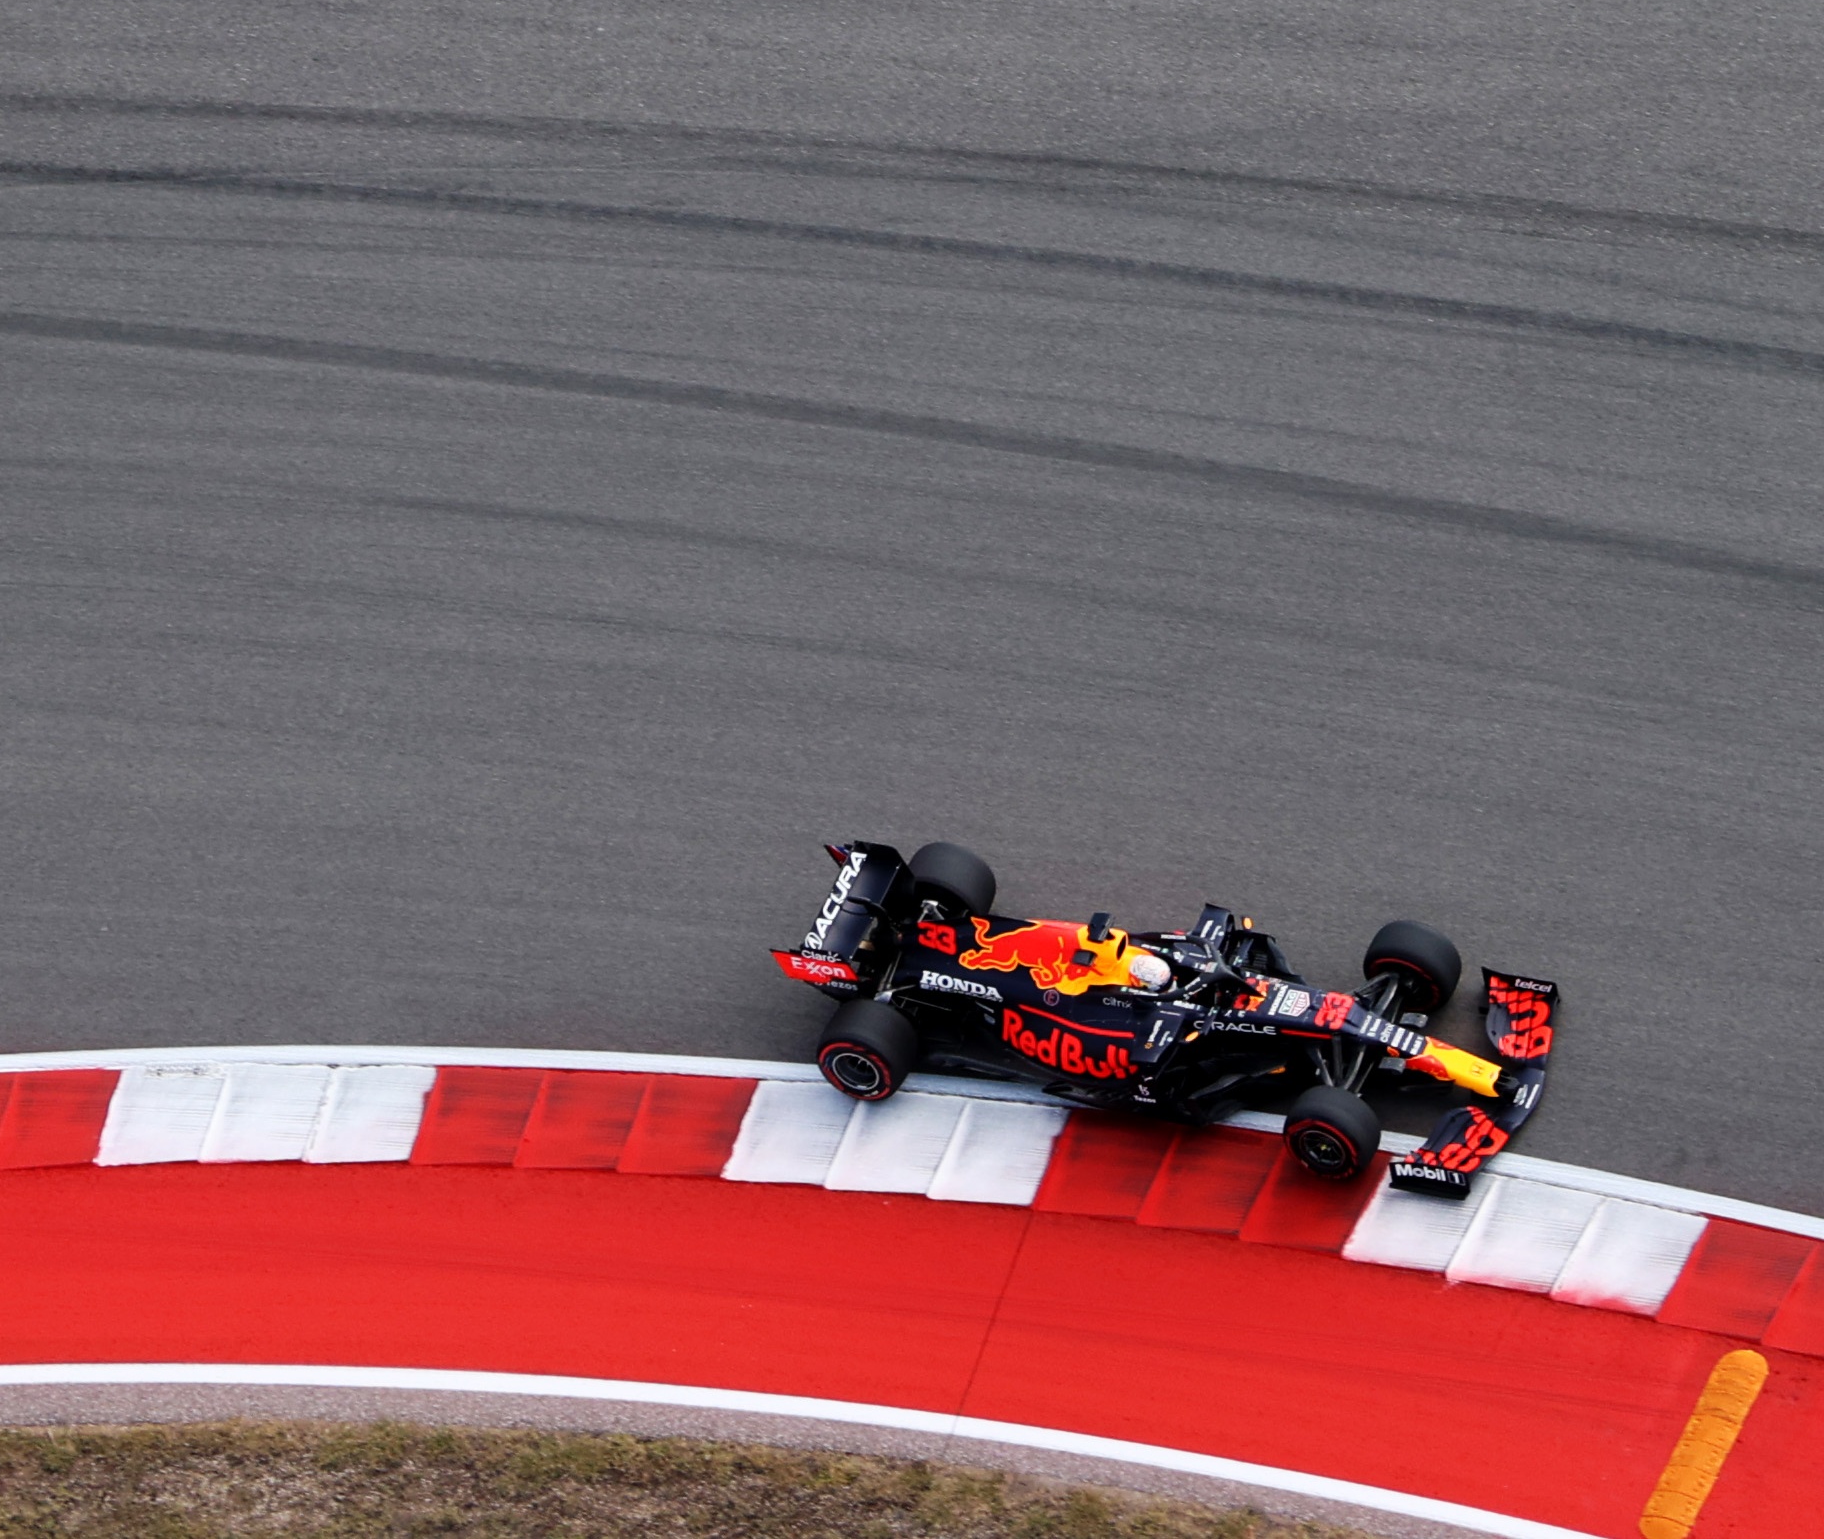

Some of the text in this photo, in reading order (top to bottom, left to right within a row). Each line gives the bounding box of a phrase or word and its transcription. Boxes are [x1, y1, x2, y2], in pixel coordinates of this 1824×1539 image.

[816, 852, 867, 939] ACURA
[918, 921, 957, 956] 33
[791, 957, 846, 978] Exxon
[801, 950, 838, 963] Claro
[920, 970, 1003, 1000] HONDA
[1515, 978, 1553, 993] telcel
[1314, 992, 1355, 1030] 33
[1395, 1164, 1446, 1181] Mobil
